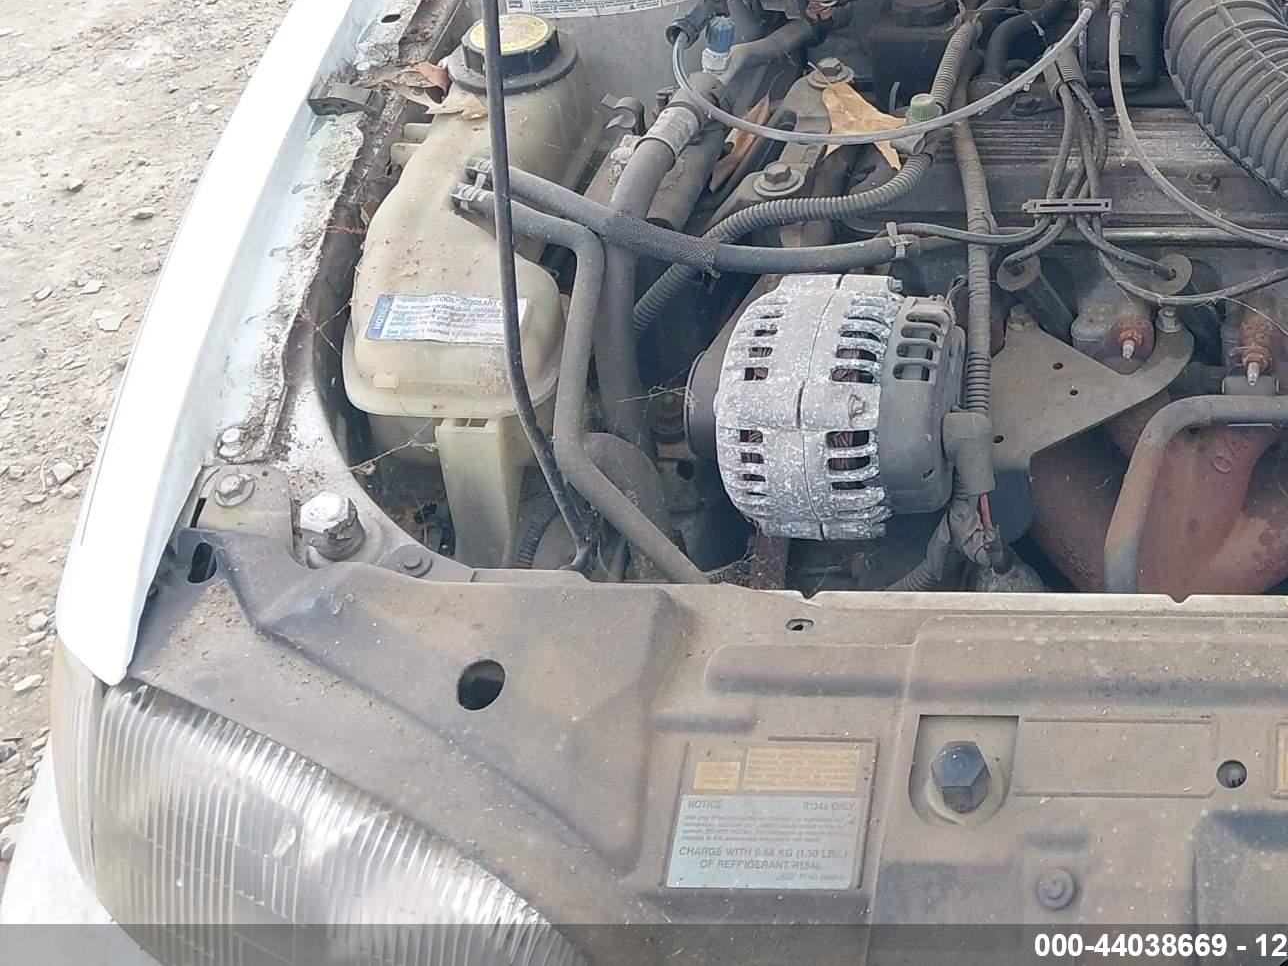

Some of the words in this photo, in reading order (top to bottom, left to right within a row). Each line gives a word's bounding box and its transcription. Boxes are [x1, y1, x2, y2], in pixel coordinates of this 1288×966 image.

[687, 799, 723, 810] NOTICE
[679, 846, 722, 858] CHARGE
[726, 847, 751, 858] WITH
[777, 848, 793, 859] KG
[796, 848, 818, 860] (1.50
[699, 859, 714, 870] OF
